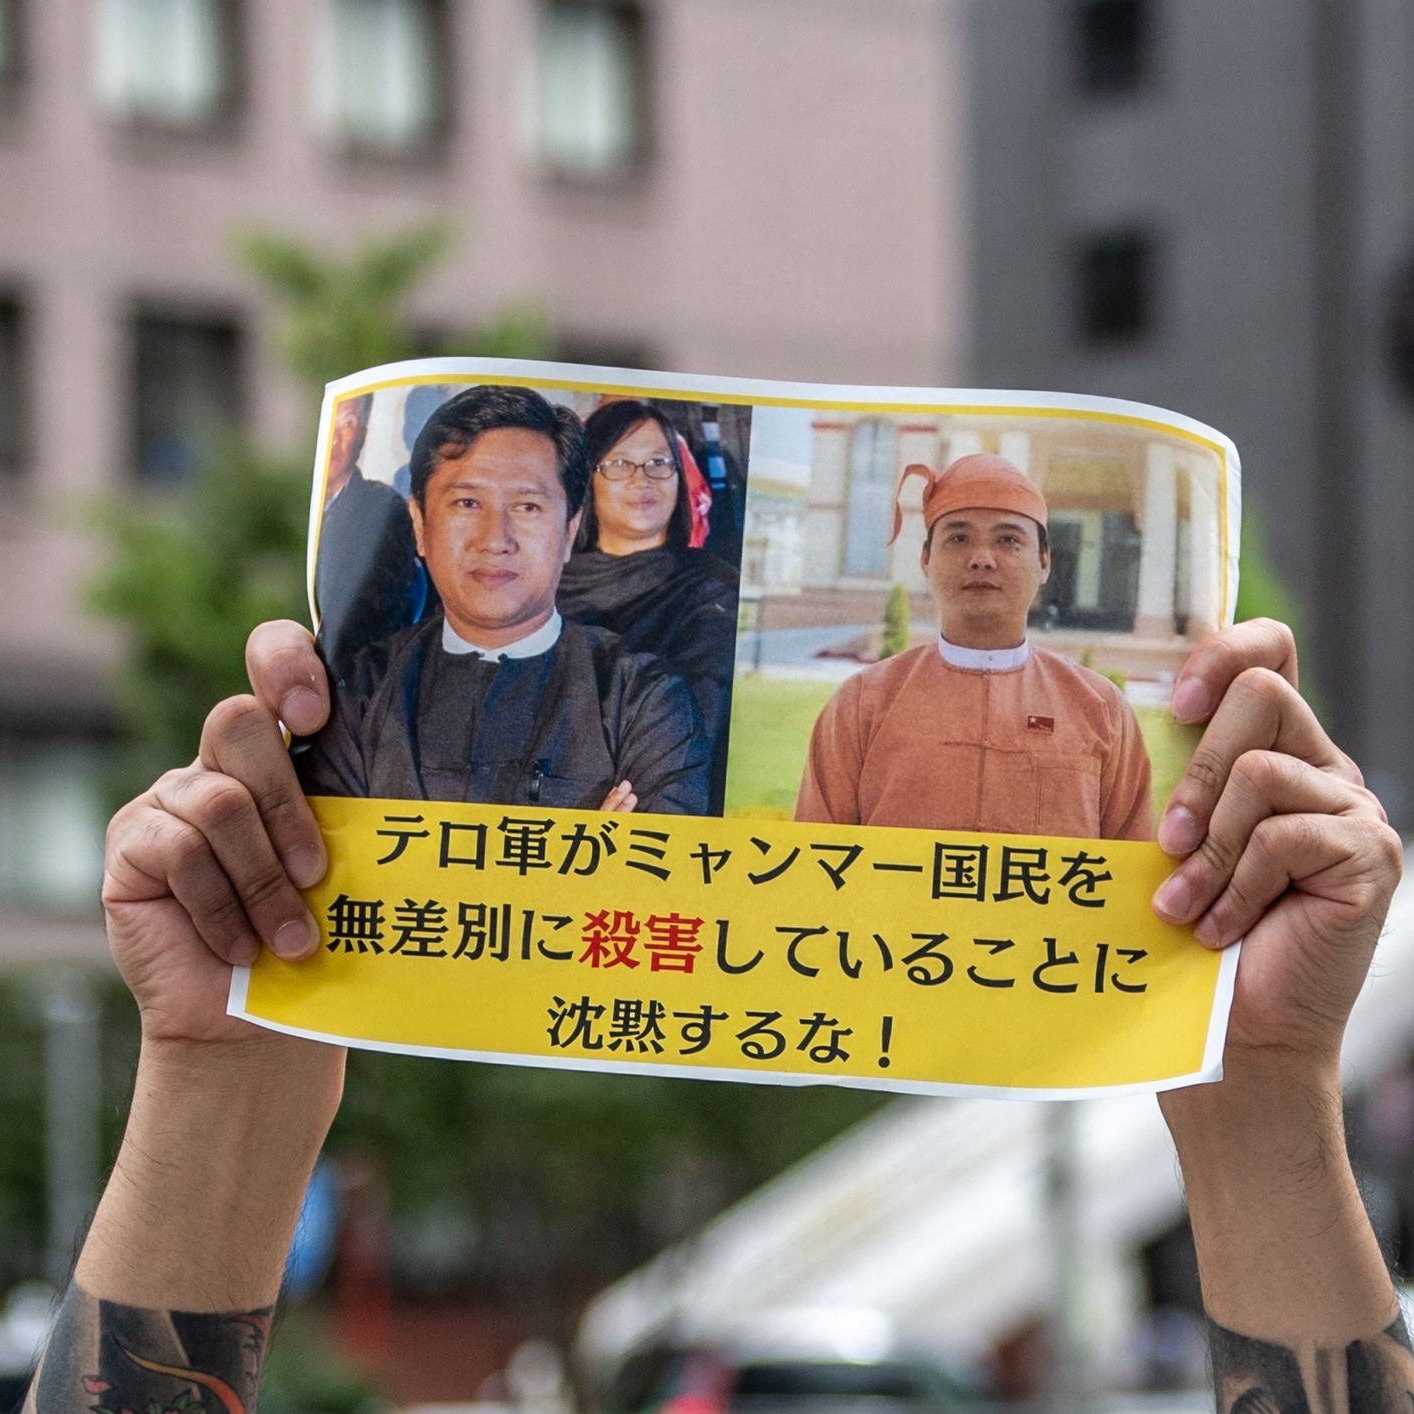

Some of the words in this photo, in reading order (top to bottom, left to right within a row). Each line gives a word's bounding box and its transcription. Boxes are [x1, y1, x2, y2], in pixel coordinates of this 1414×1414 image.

[375, 813, 1113, 908] テロ軍がミャンマー国民を
[326, 893, 1149, 994] 無差別に殺害していることに
[545, 995, 894, 1069] 沈黙するな！
